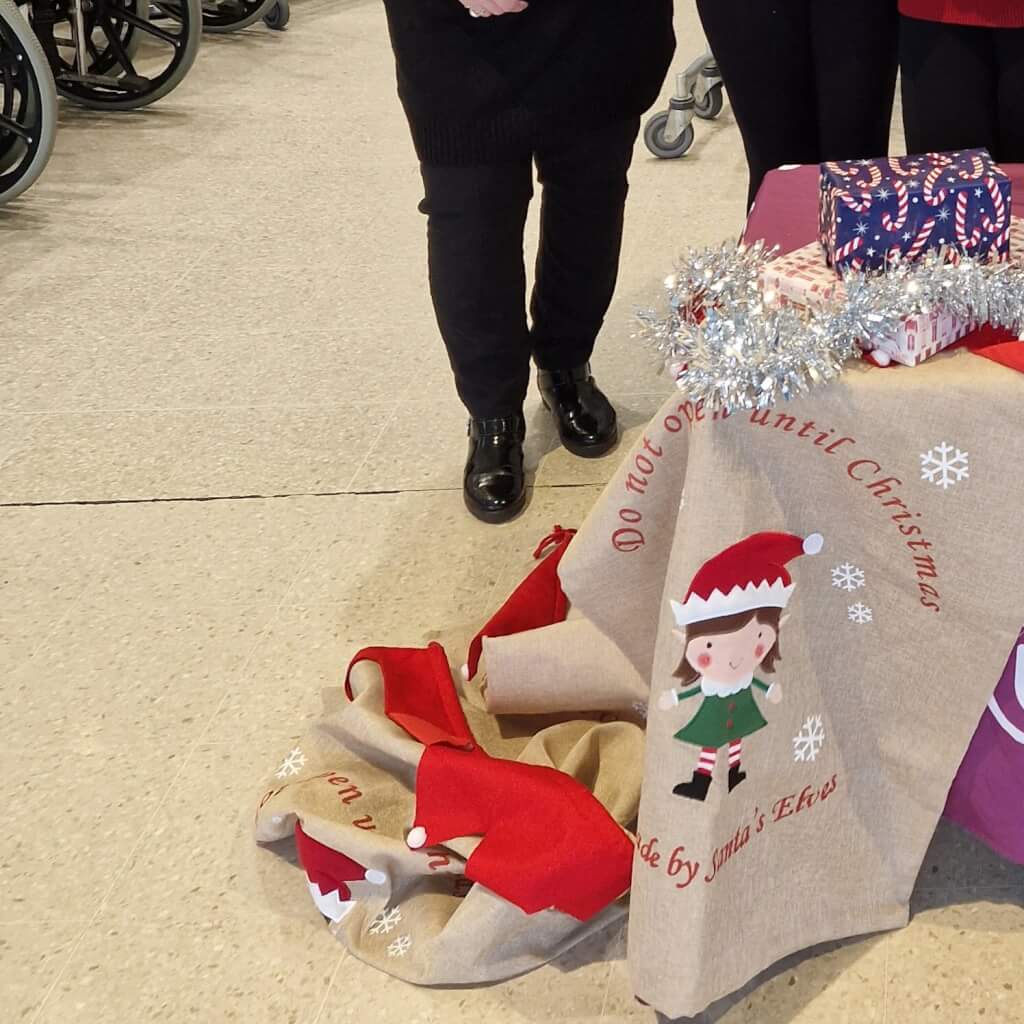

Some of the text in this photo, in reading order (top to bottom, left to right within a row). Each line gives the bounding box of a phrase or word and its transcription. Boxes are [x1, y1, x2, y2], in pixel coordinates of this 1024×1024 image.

[750, 406, 857, 455] until
[626, 436, 663, 495] not
[611, 508, 646, 553] Do
[846, 459, 941, 613] Christmas
[666, 845, 700, 888] by
[704, 806, 765, 883] Santa's
[771, 773, 838, 823] Elves
